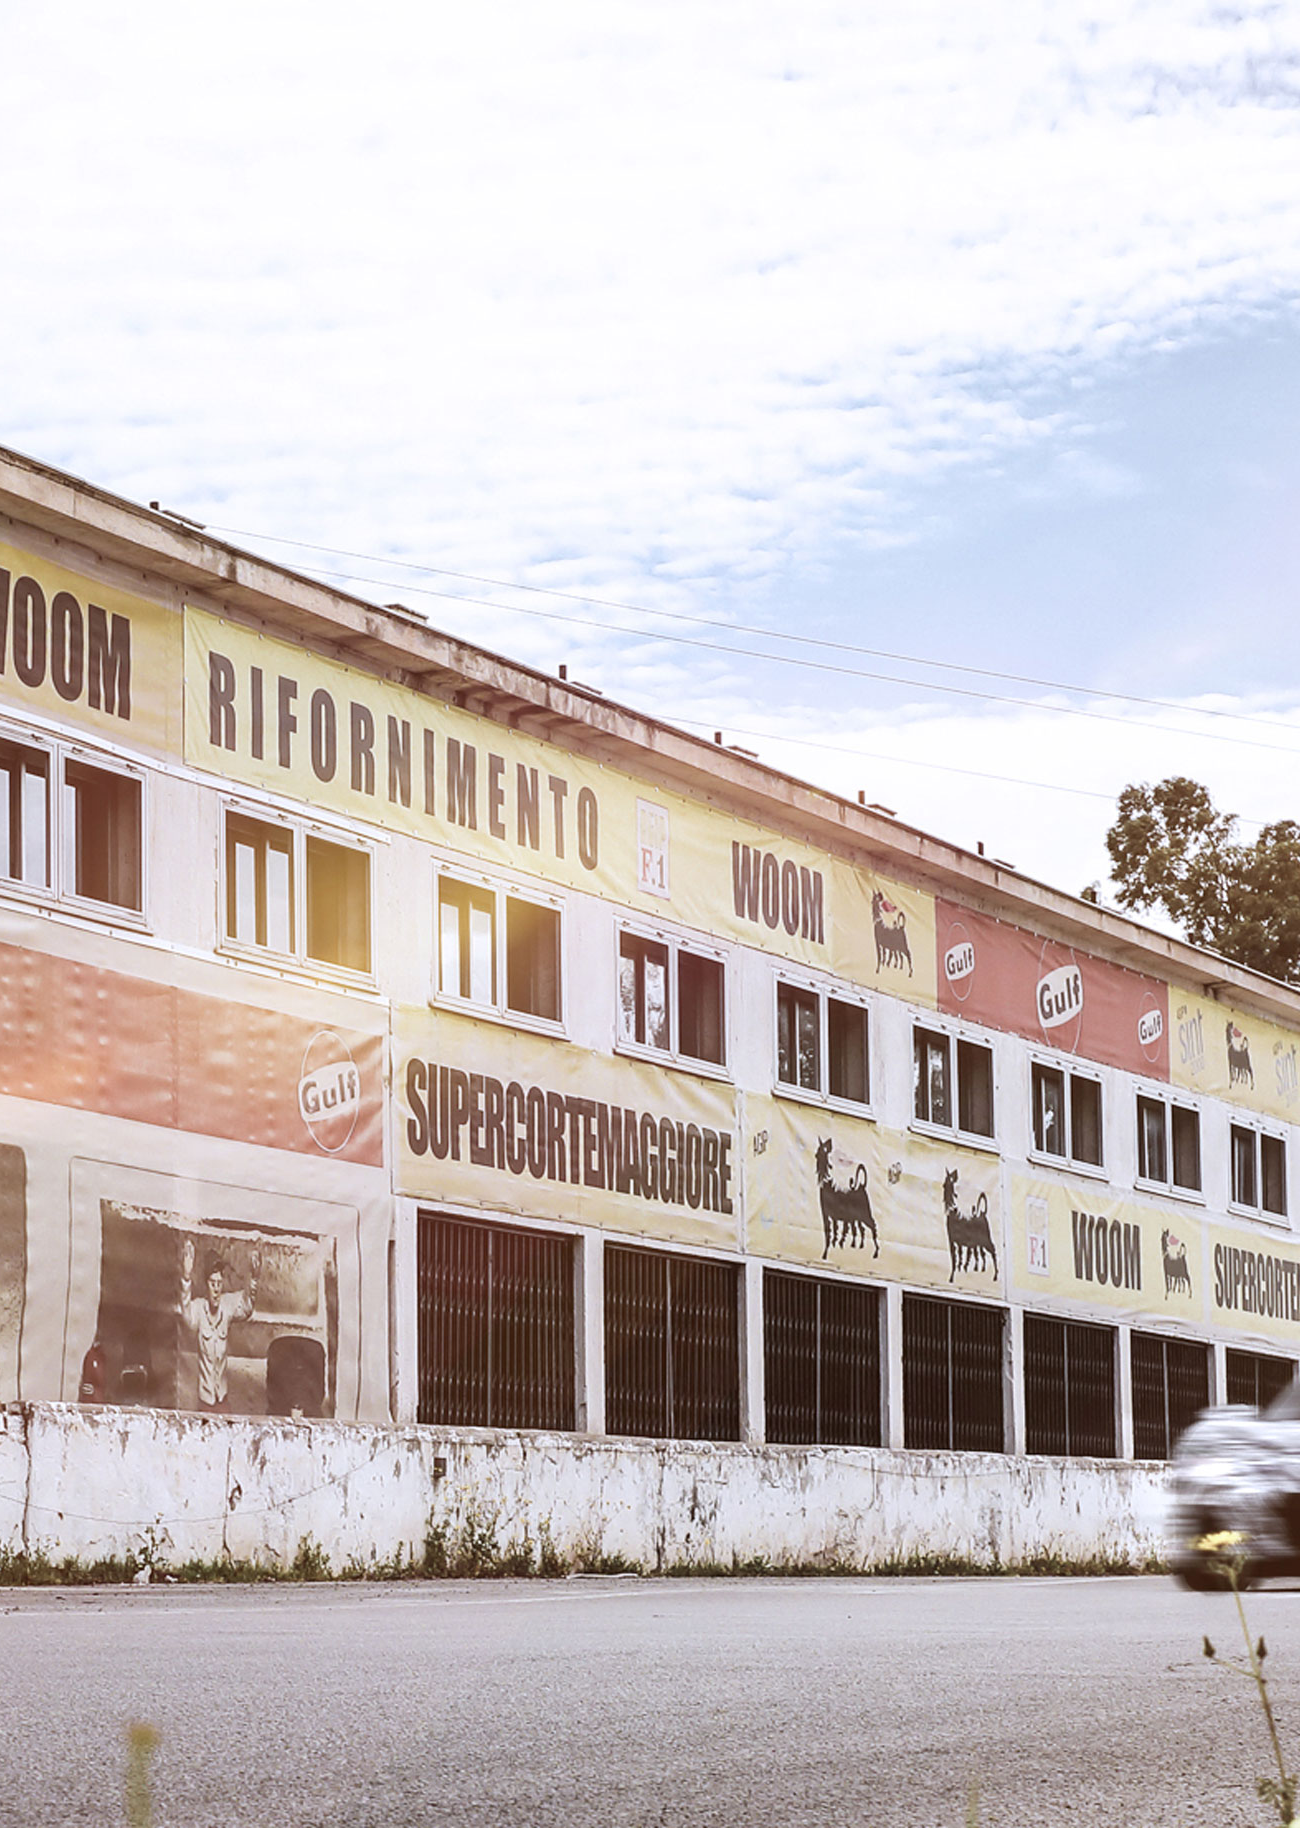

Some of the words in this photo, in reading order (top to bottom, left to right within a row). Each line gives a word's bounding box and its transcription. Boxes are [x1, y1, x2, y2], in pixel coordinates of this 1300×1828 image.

[209, 650, 599, 871] RIFORNIMENTO
[732, 840, 824, 945] WOOM
[946, 948, 973, 975] Gulf
[1039, 973, 1081, 1020] Gulf
[1139, 1014, 1162, 1040] Gulf
[302, 1069, 356, 1115] Gulf
[406, 1058, 733, 1215] SUPERCORTEMAGGIORE
[1072, 1210, 1141, 1290] WOOM
